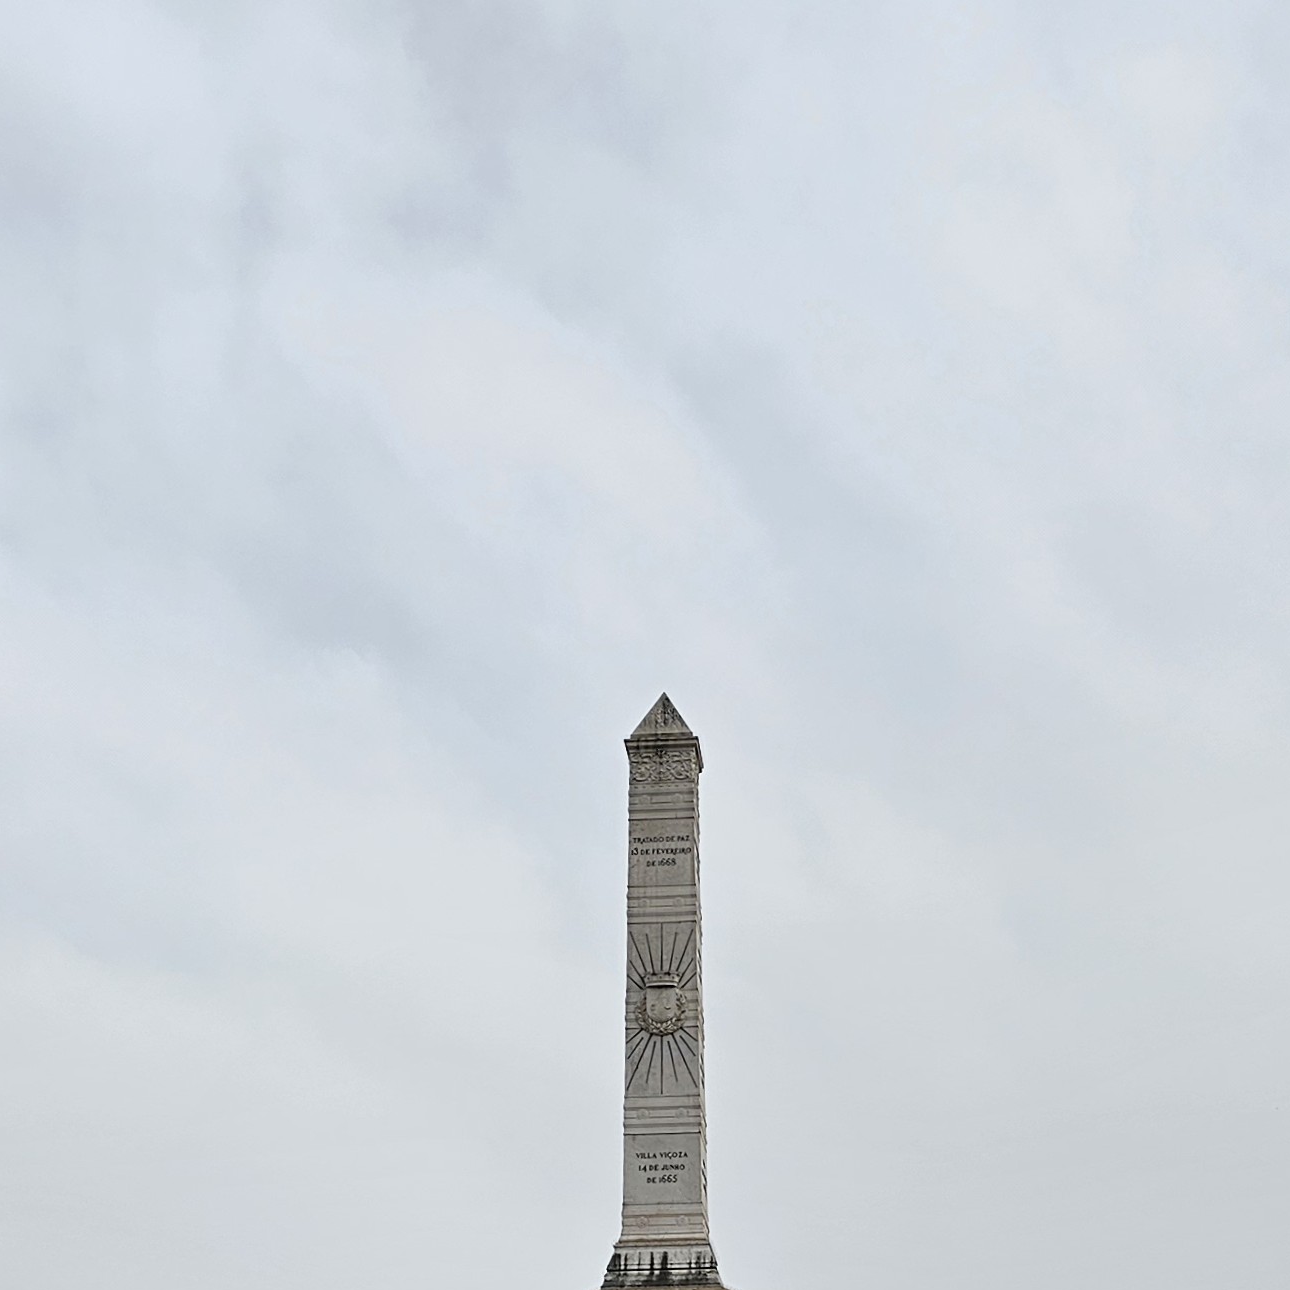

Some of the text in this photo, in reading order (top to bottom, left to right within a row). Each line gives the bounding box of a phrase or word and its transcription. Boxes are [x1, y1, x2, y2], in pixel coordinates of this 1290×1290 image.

[632, 836, 664, 844] TRATADO
[631, 847, 638, 855] 13
[652, 847, 691, 855] FEVEREIRO
[659, 1151, 688, 1159] VIÇOZA
[638, 1164, 647, 1172] 14
[658, 1174, 677, 1183] 1665
